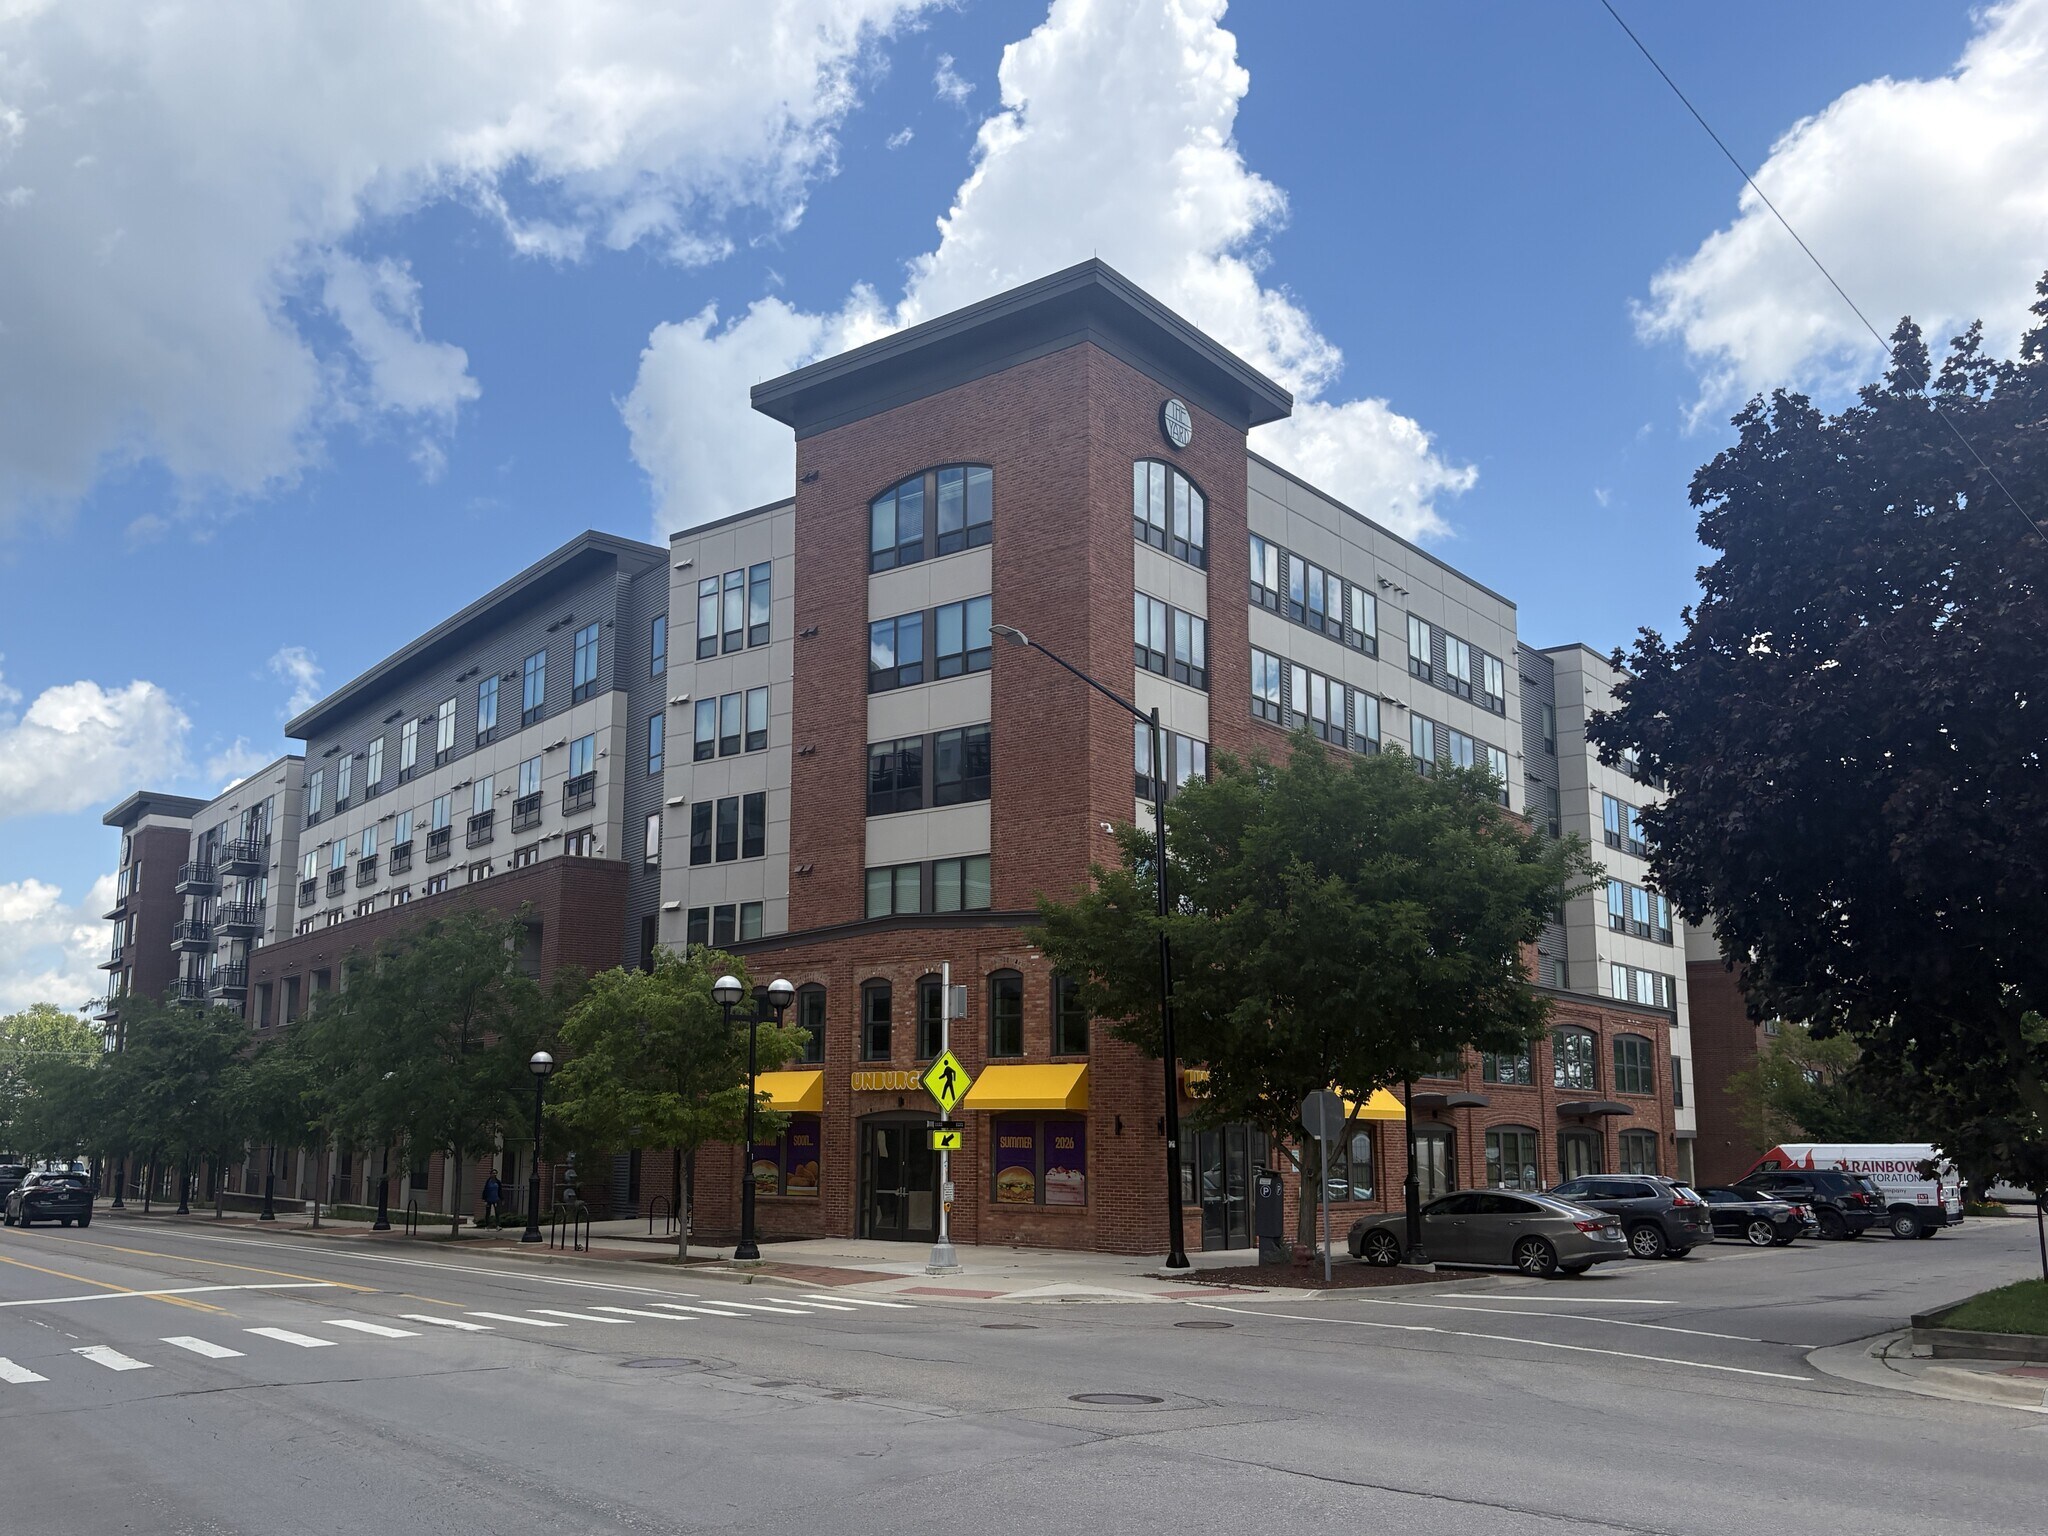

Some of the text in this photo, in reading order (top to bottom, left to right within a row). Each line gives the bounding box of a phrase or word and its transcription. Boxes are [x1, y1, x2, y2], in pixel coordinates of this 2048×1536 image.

[1167, 419, 1191, 444] YARD
[1000, 1136, 1032, 1148] SUMMER
[1055, 1137, 1075, 1149] 2026
[1852, 1161, 1919, 1172] RAINBOW
[1869, 1174, 1920, 1183] TORATION
